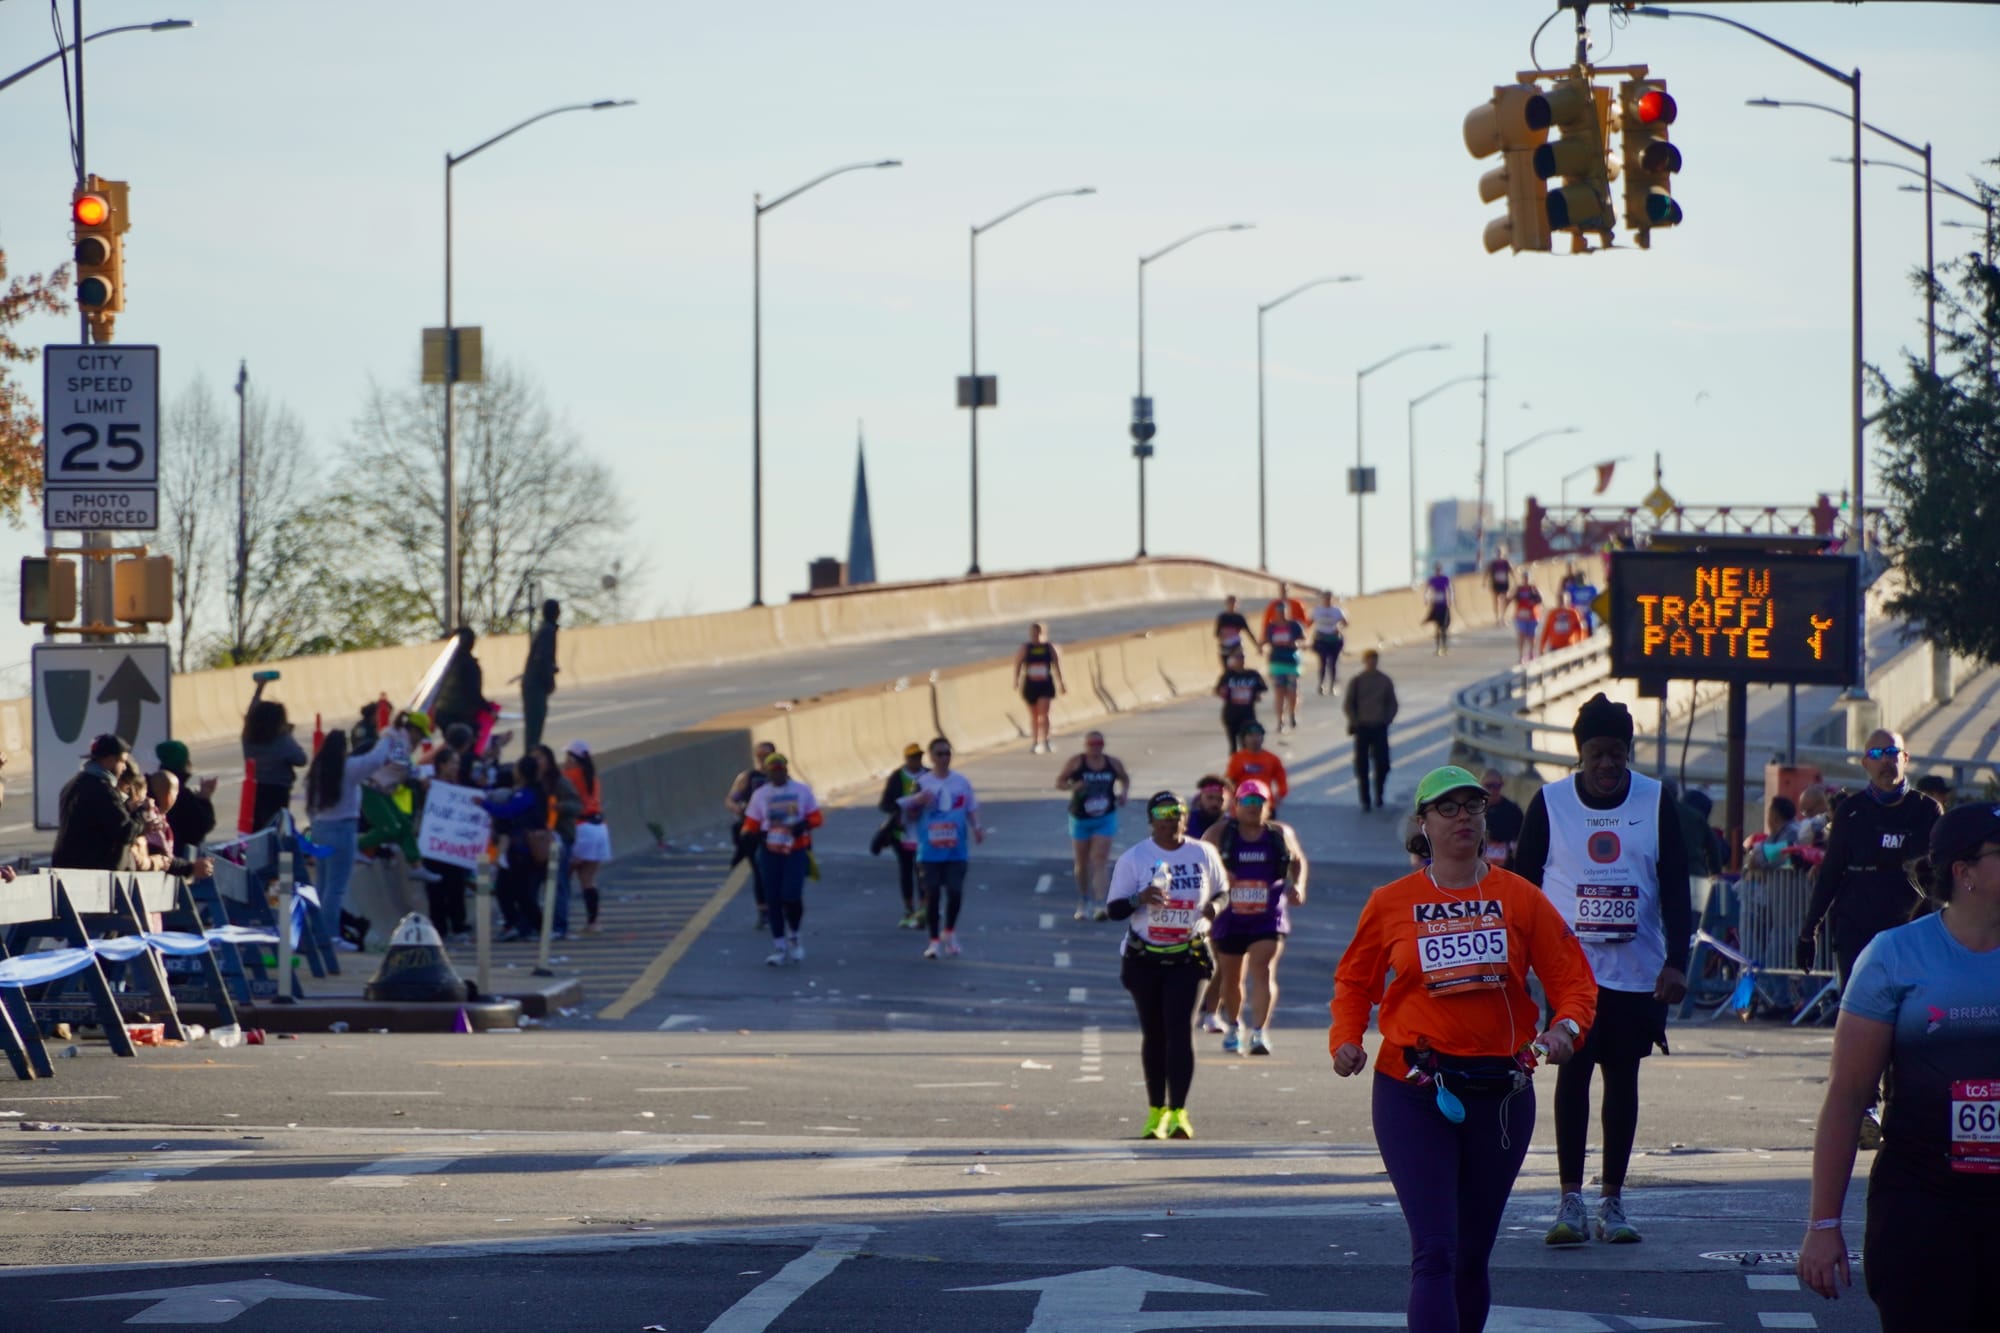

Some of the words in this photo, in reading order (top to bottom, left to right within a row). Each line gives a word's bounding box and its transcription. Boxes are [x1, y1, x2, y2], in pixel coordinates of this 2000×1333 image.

[77, 355, 122, 371] CITY
[67, 377, 132, 392] SPEED
[74, 399, 126, 414] LIMIT
[60, 422, 144, 473] 25
[72, 494, 130, 508] PHOTO
[54, 510, 148, 524] ENFORCED
[1695, 566, 1771, 598] NEW
[1643, 625, 1770, 659] PATTE
[1586, 818, 1620, 827] TIMOTHY
[1881, 833, 1906, 849] RAY
[1610, 866, 1630, 875] House
[1415, 900, 1503, 922] KASHA
[1579, 899, 1635, 919] 63286
[1427, 922, 1447, 934] tcs
[1425, 931, 1504, 962] 65505
[1966, 1083, 1989, 1098] tcs
[1959, 1104, 2000, 1132] 66
